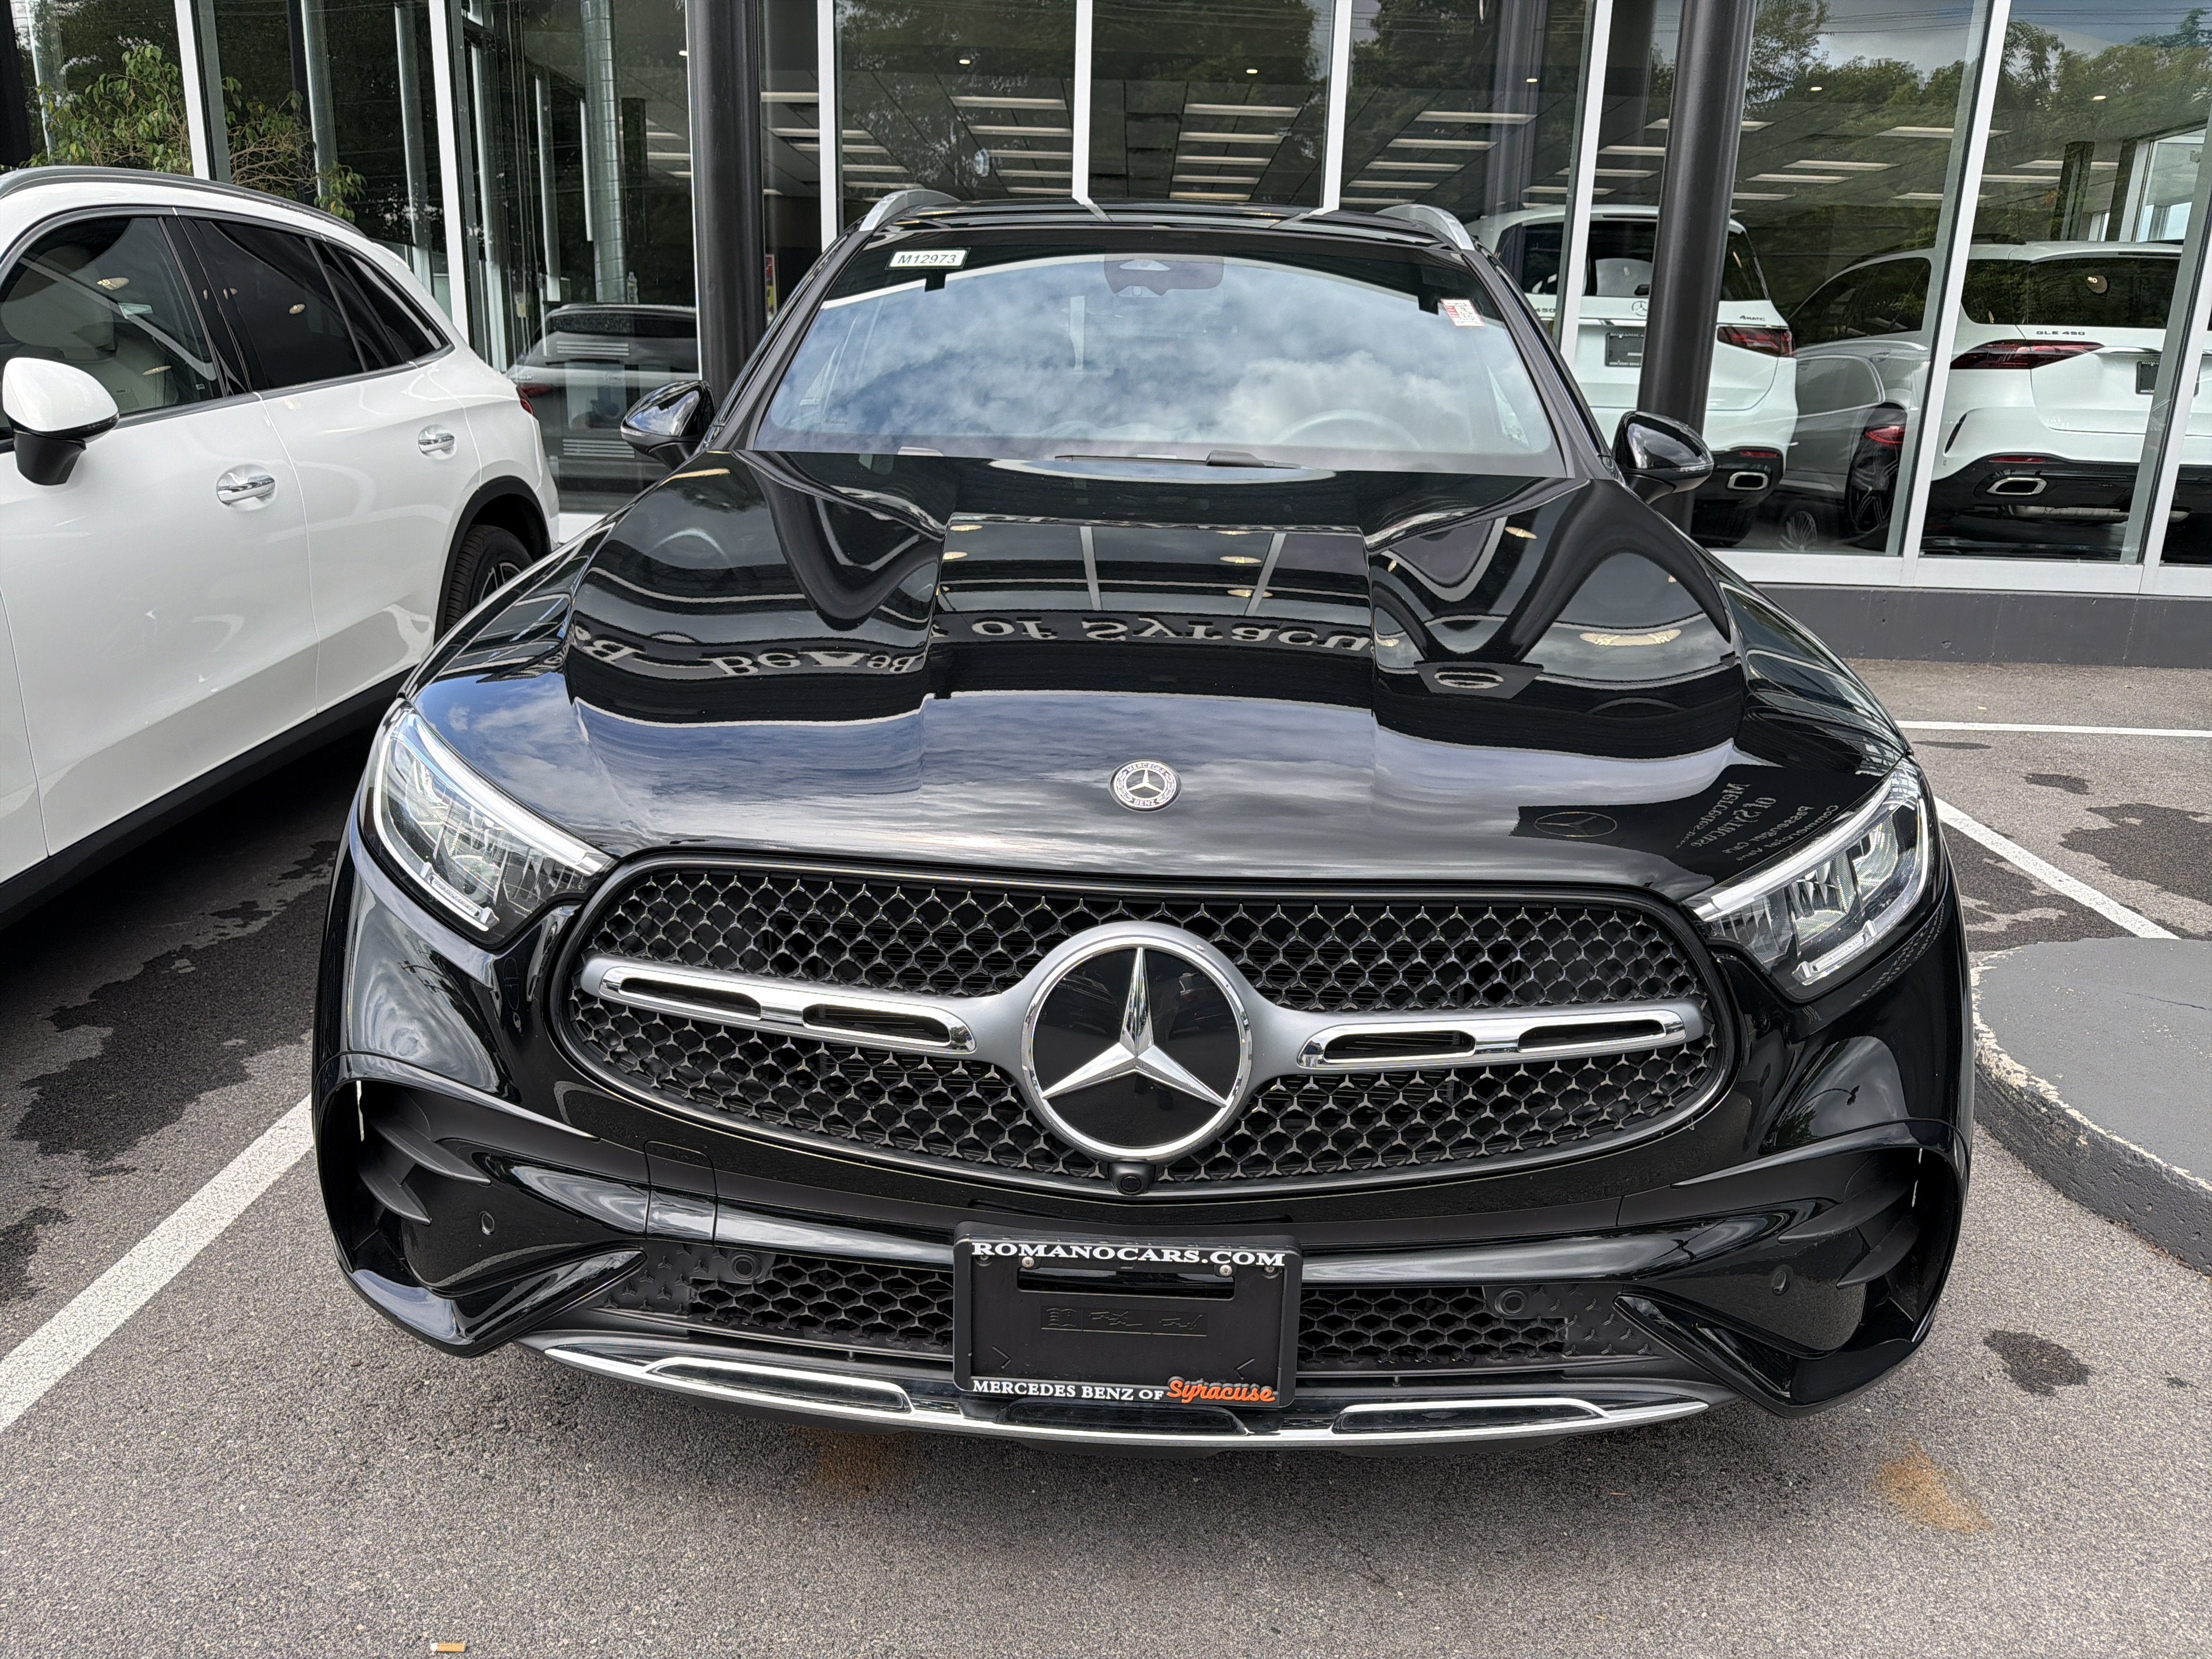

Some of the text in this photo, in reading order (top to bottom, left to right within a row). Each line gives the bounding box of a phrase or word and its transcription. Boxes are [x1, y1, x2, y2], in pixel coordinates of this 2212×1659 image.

[897, 254, 957, 264] M12973
[1127, 764, 1166, 774] MERCEDES
[971, 1242, 1285, 1267] ROMANOCARS.COM
[973, 1379, 1277, 1404] MERCEDES BENZ OF Syracuse
